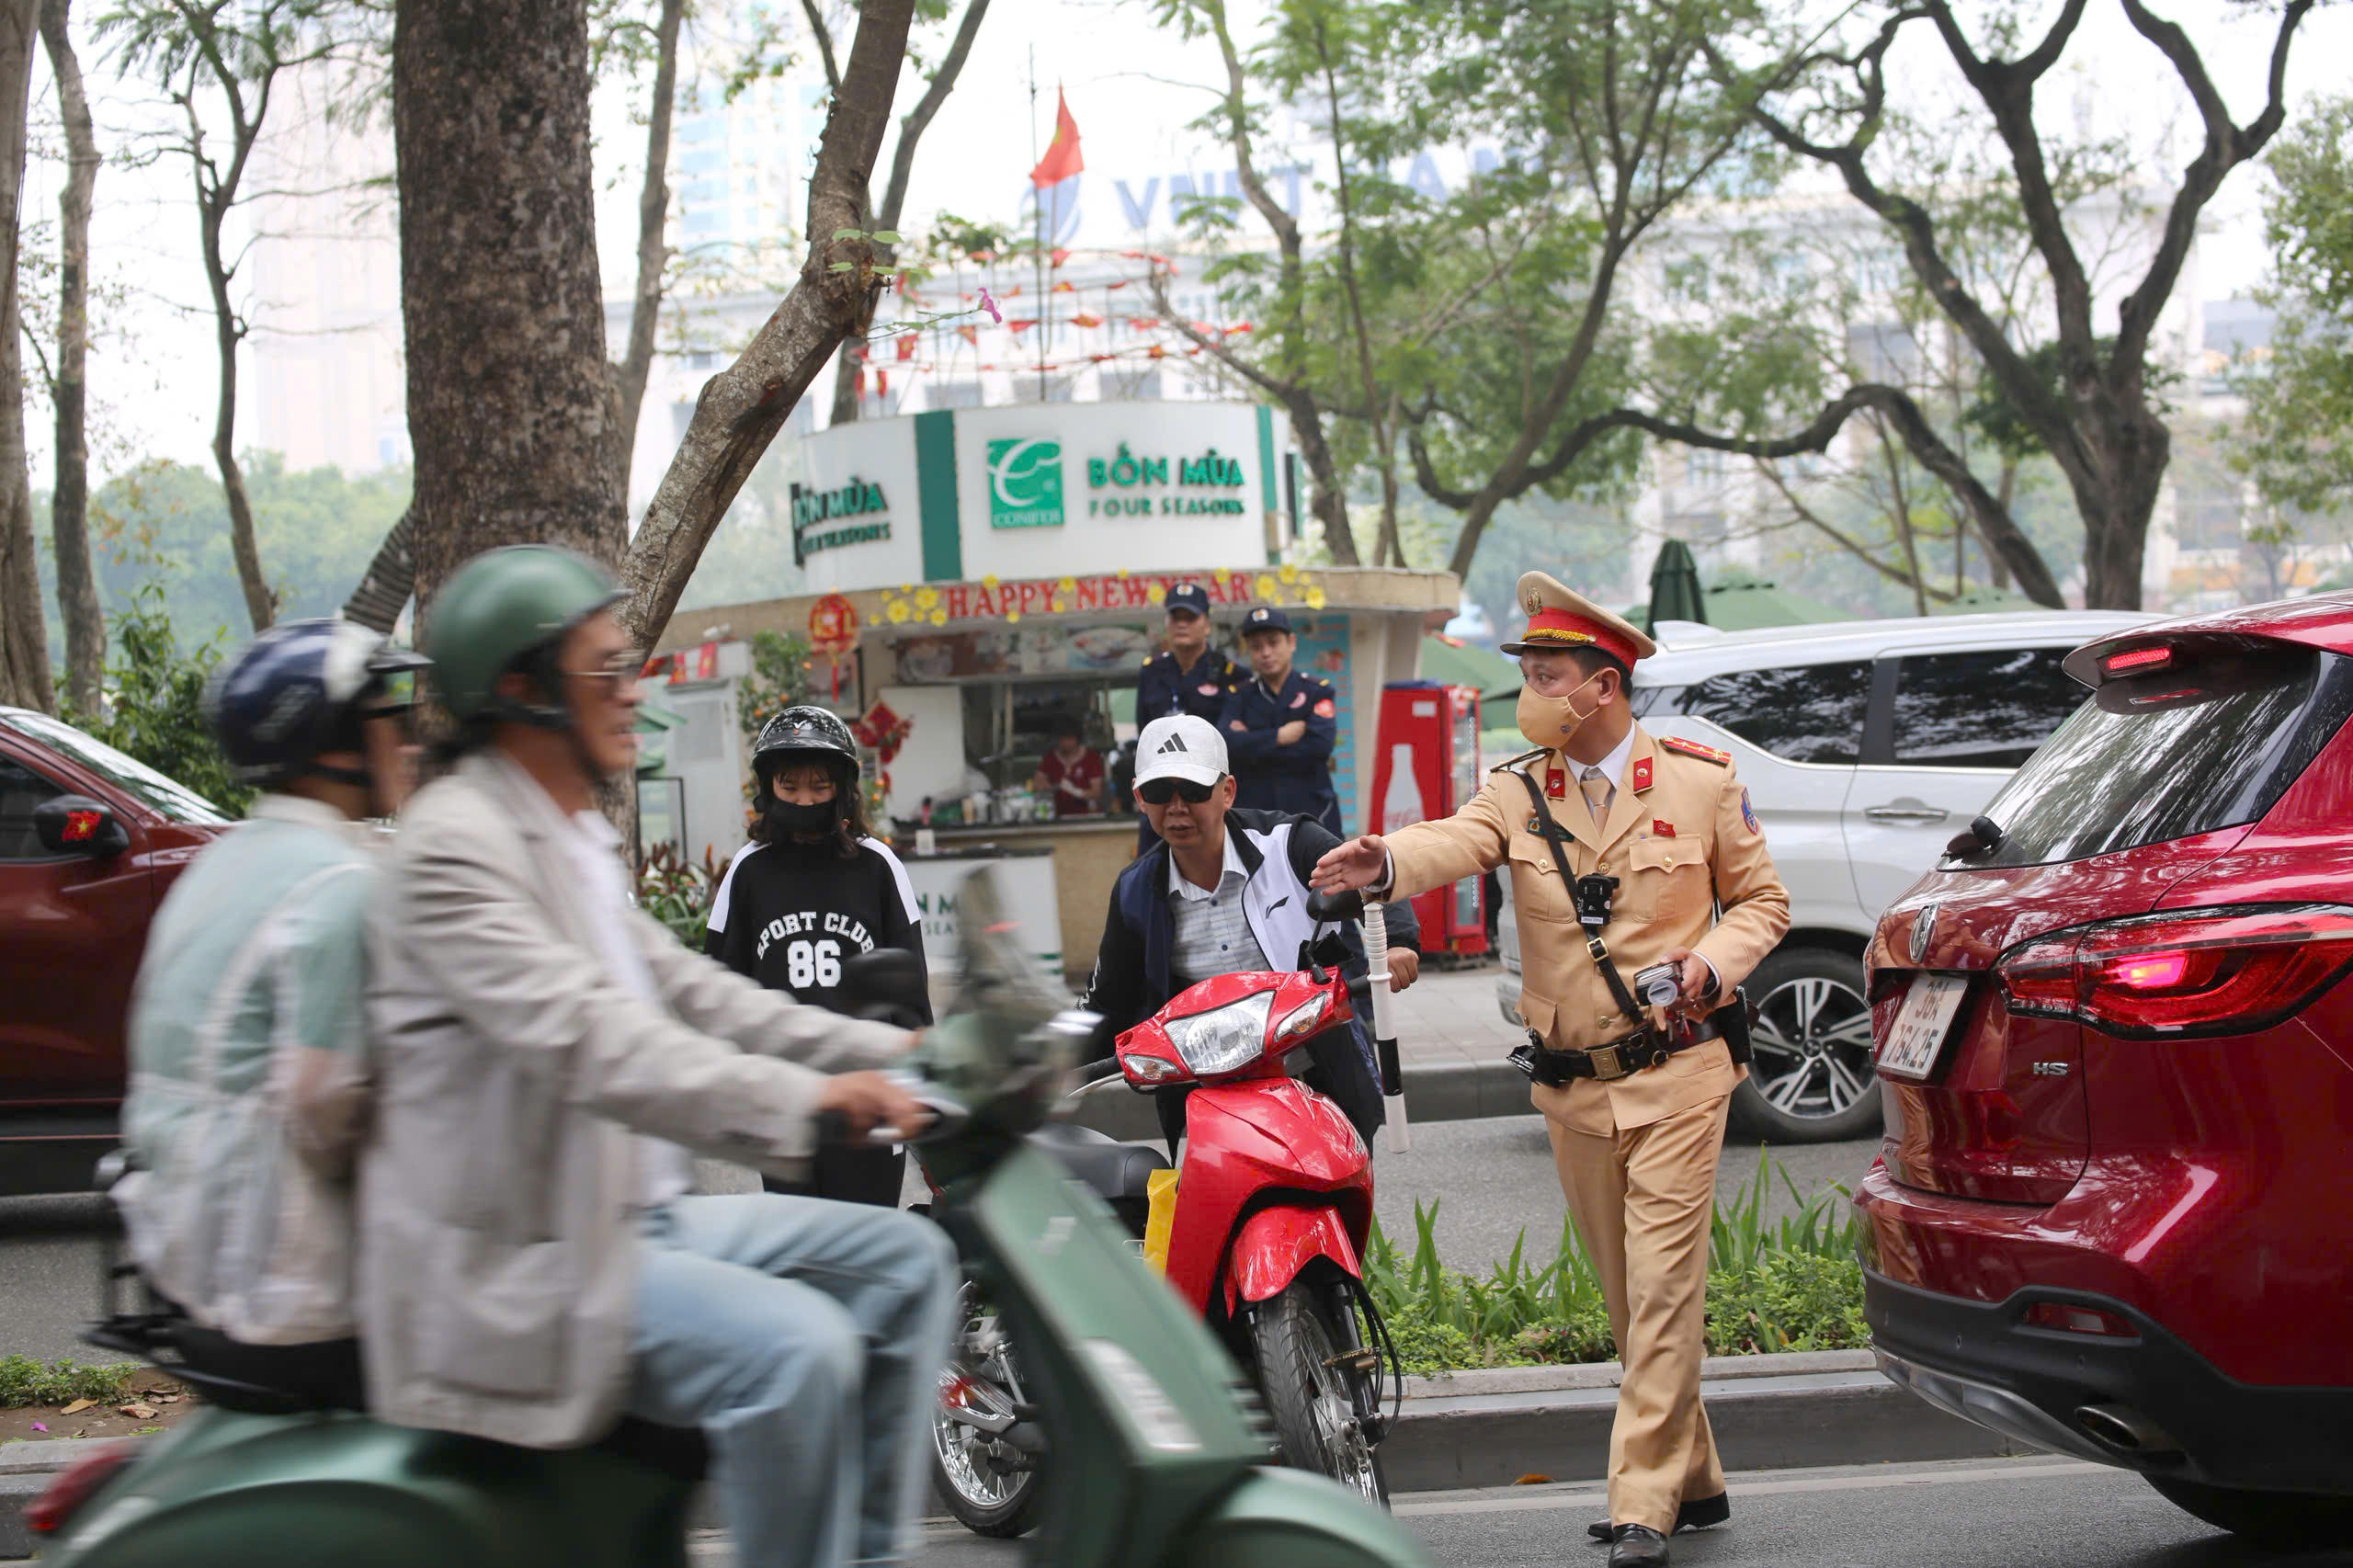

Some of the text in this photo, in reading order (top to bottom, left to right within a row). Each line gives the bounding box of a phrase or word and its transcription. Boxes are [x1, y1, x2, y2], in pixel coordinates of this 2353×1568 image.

[1114, 165, 1314, 230] VNT
[1179, 448, 1245, 487] MÙA
[1089, 496, 1245, 517] FOUR SEASONS
[945, 572, 1254, 619] HAPPY NEW YAR
[757, 912, 875, 960] SPORT CLUB
[787, 939, 842, 989] 86
[2033, 1062, 2069, 1075] HS
